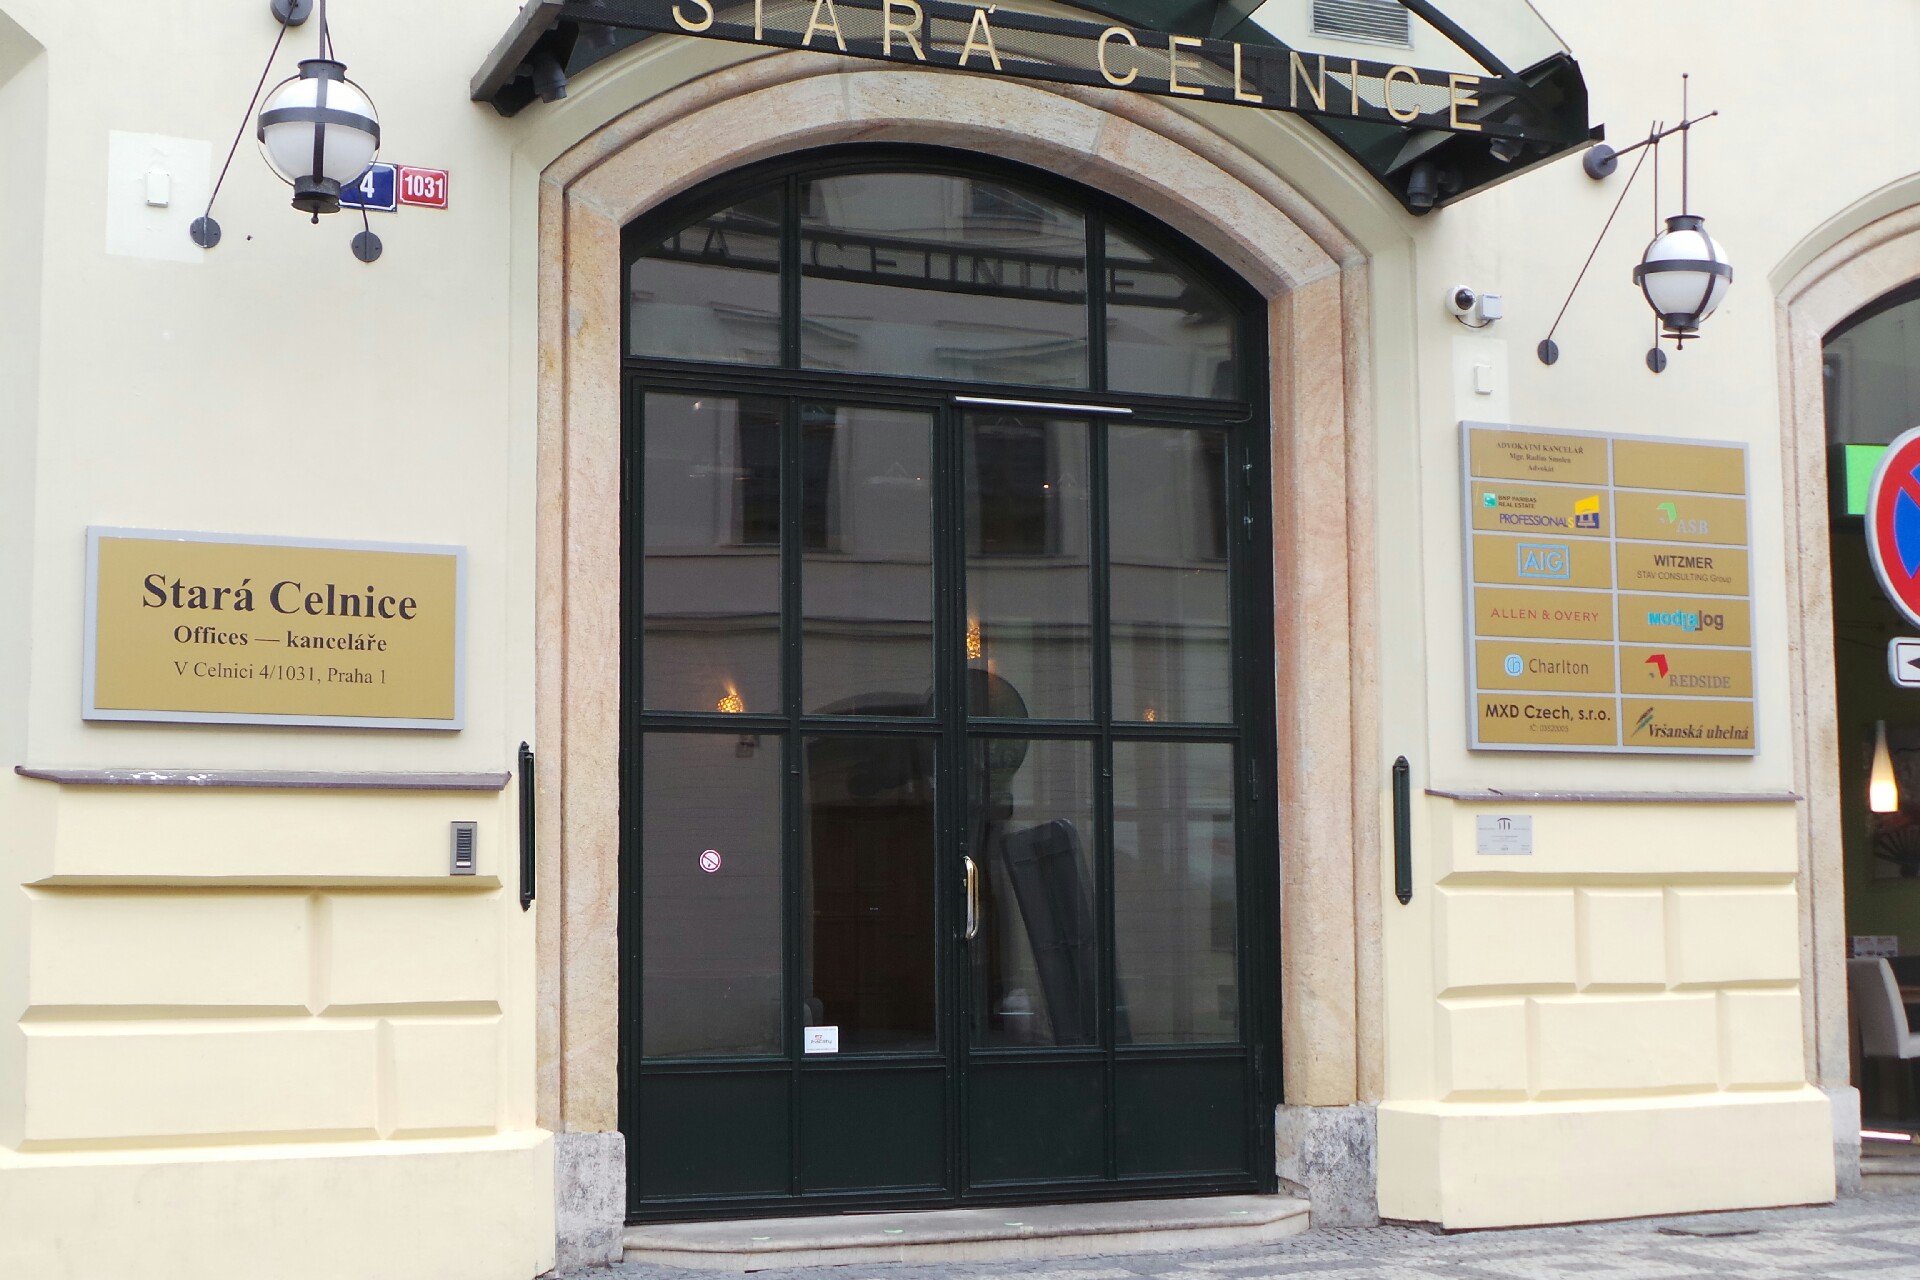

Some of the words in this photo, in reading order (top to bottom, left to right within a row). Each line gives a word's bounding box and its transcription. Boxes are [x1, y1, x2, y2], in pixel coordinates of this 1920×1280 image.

[1097, 26, 1483, 132] CELNICE
[360, 170, 374, 198] 4
[404, 174, 443, 199] 1031
[1500, 513, 1575, 529] PROFESSIONALS
[1677, 519, 1710, 535] ASB
[1524, 550, 1563, 572] AIG
[1653, 554, 1713, 570] WITZMER
[143, 573, 255, 612] Stará
[269, 580, 417, 621] Celnice
[1491, 608, 1537, 620] ALLEN
[1542, 609, 1550, 621] &
[1555, 610, 1599, 622] OVERY
[174, 625, 249, 646] Offices
[287, 630, 388, 652] kanceláře
[174, 661, 188, 676] V
[193, 661, 254, 680] Celnici
[259, 664, 321, 684] 4/1031,
[327, 667, 373, 684] Praha
[380, 669, 386, 684] 1
[1528, 658, 1589, 675] Charlton
[1669, 673, 1731, 689] REDSIDE
[1486, 704, 1519, 719] MXD
[1524, 704, 1574, 721] Czech,
[1578, 709, 1611, 721] s.r.o.
[1649, 723, 1703, 739] Vršanská
[1706, 725, 1749, 740] uhelná
